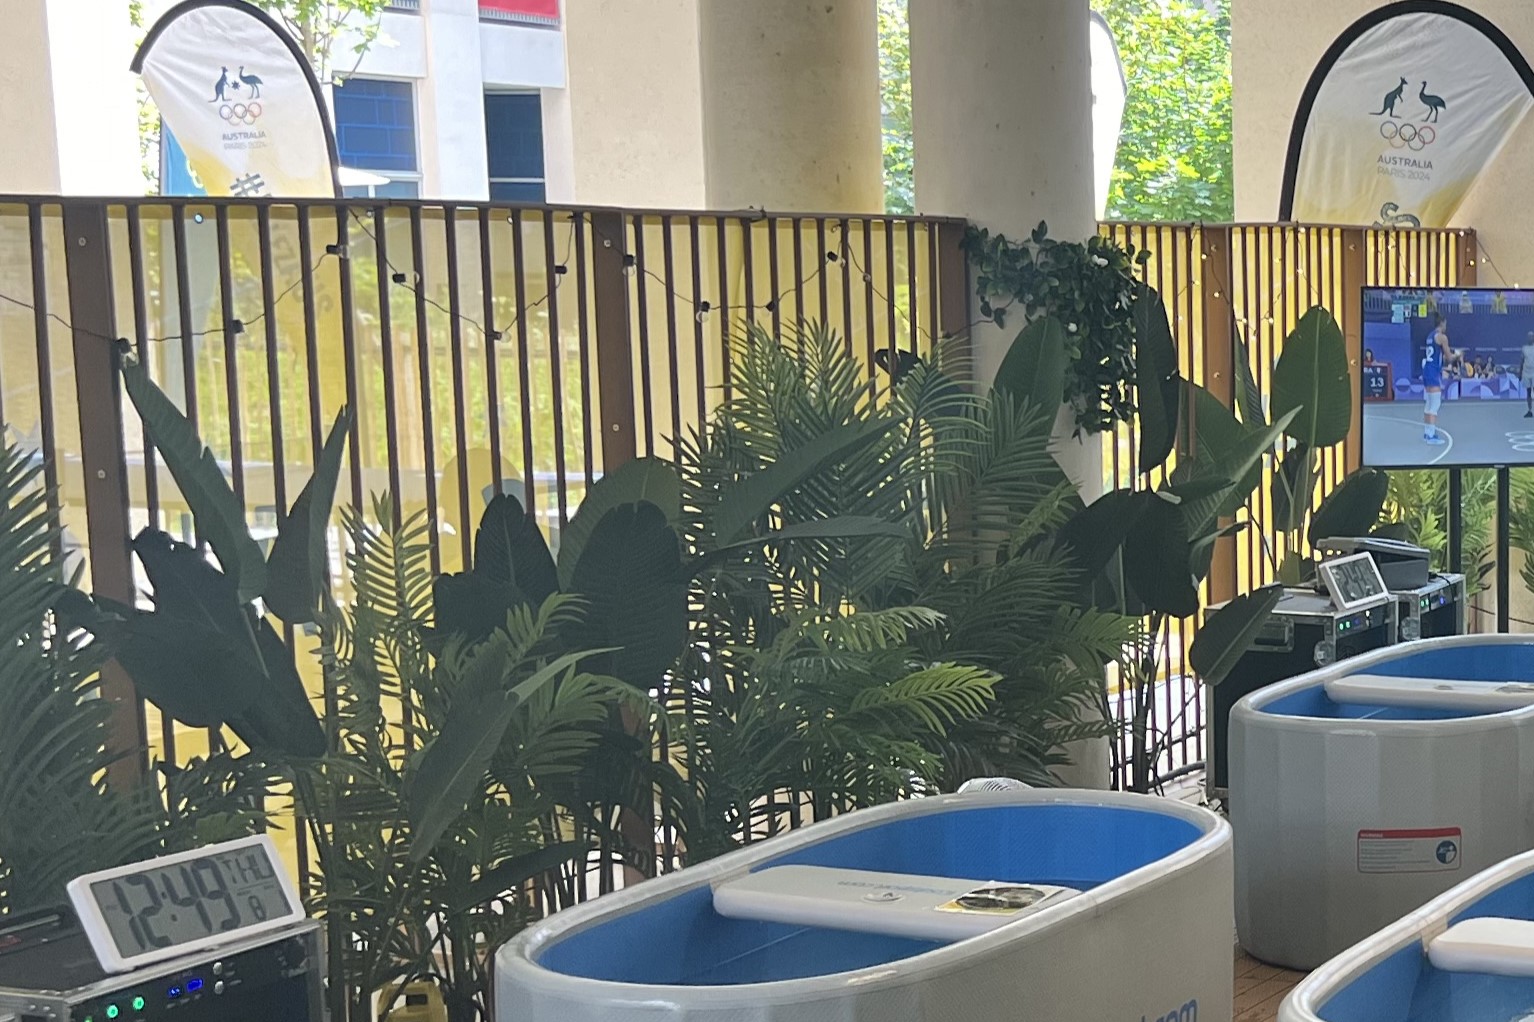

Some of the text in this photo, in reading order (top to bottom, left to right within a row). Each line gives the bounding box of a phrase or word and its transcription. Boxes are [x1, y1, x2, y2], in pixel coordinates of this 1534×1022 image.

[222, 131, 266, 141] AUSTRALIA
[1377, 154, 1433, 170] AUSTRALIA
[1377, 166, 1431, 181] PARIS 2024
[222, 852, 275, 885] THU
[112, 858, 242, 950] 12:49
